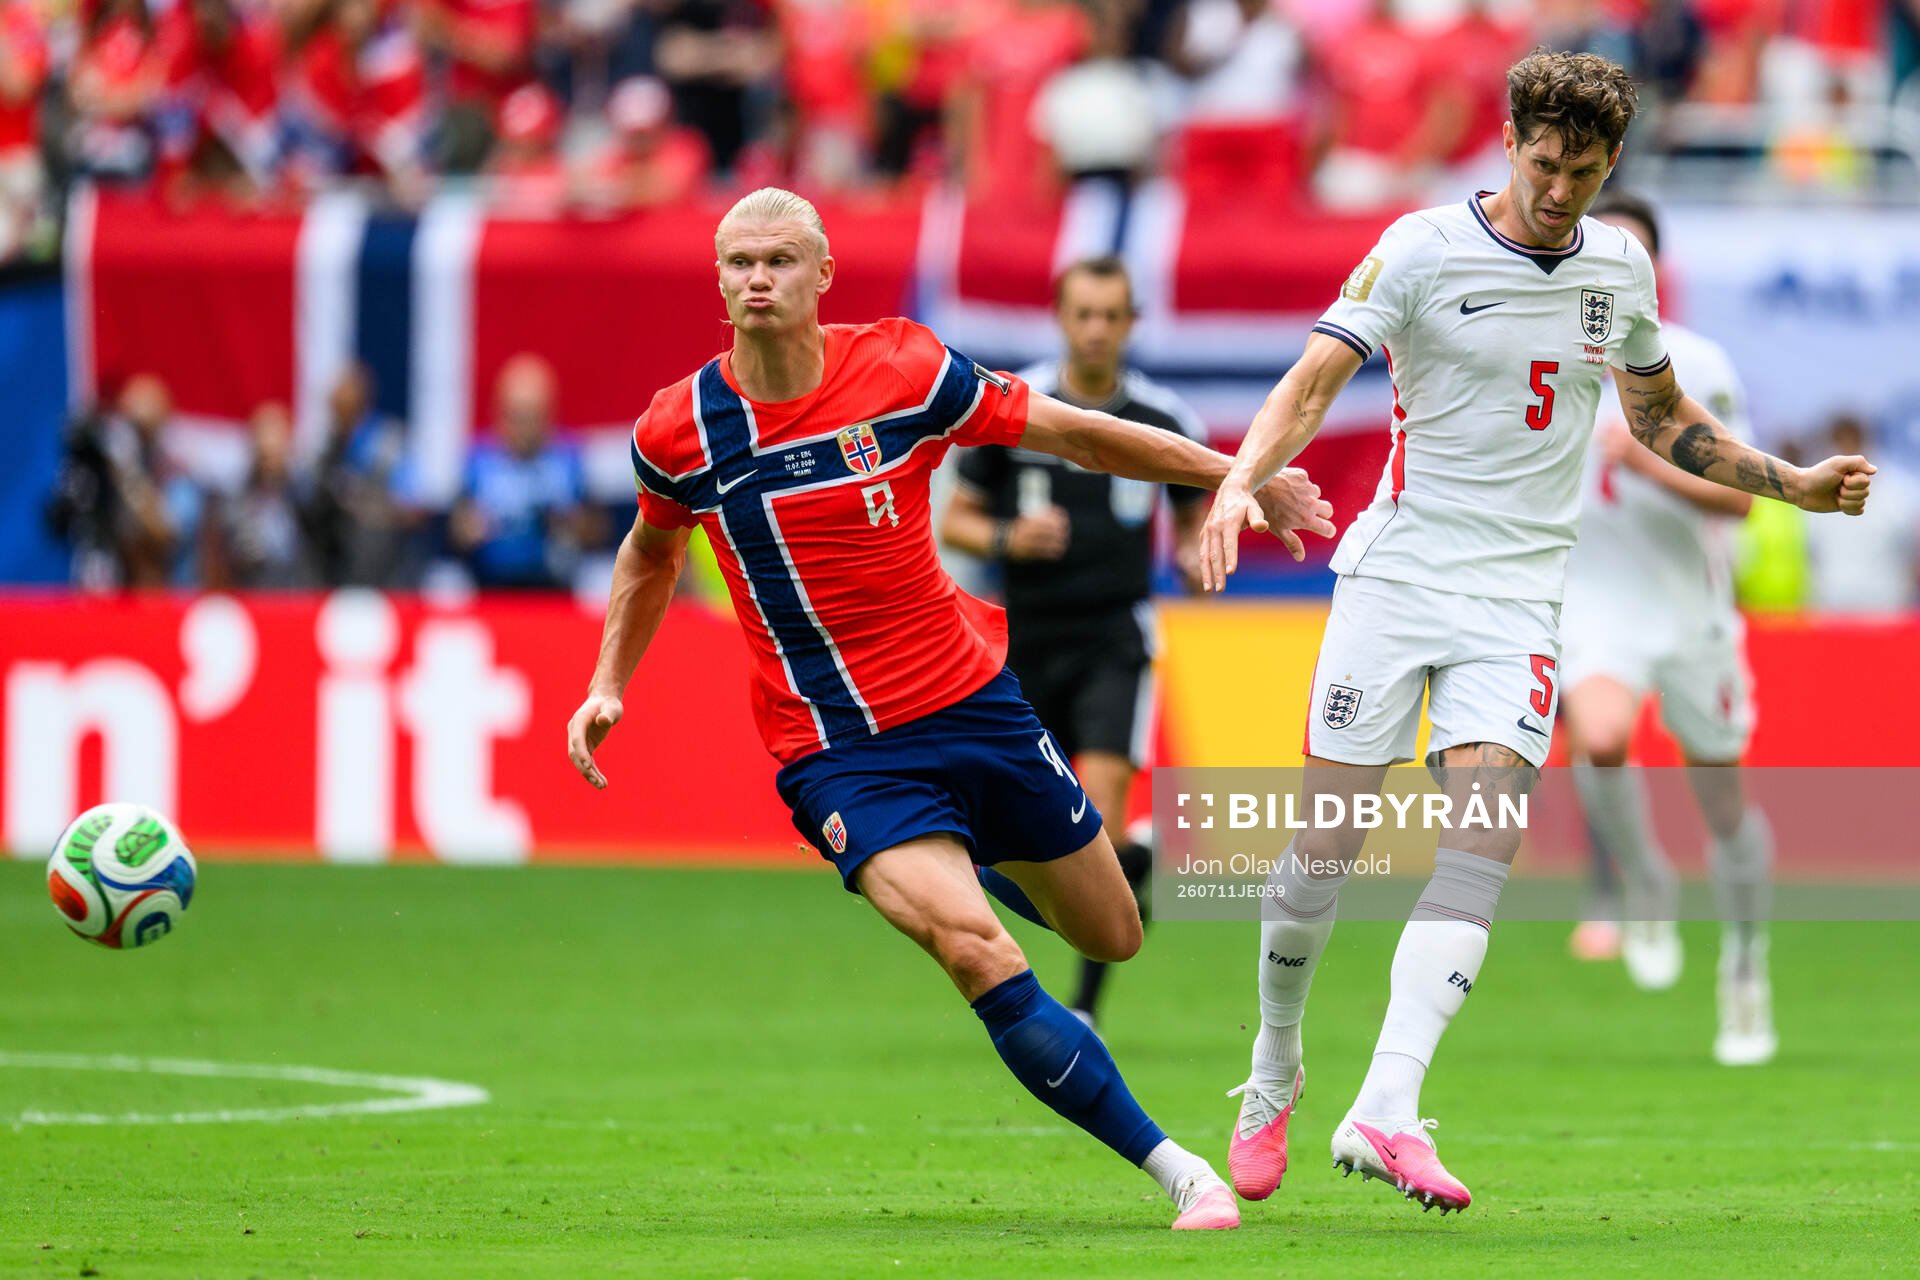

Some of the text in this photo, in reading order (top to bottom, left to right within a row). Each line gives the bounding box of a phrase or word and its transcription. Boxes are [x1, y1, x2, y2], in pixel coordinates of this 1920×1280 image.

[1584, 344, 1606, 355] NORWAY
[1525, 361, 1559, 430] 5
[1529, 654, 1555, 718] 5
[316, 588, 531, 864] it
[1268, 950, 1307, 967] ENG
[1448, 971, 1472, 996] EN
